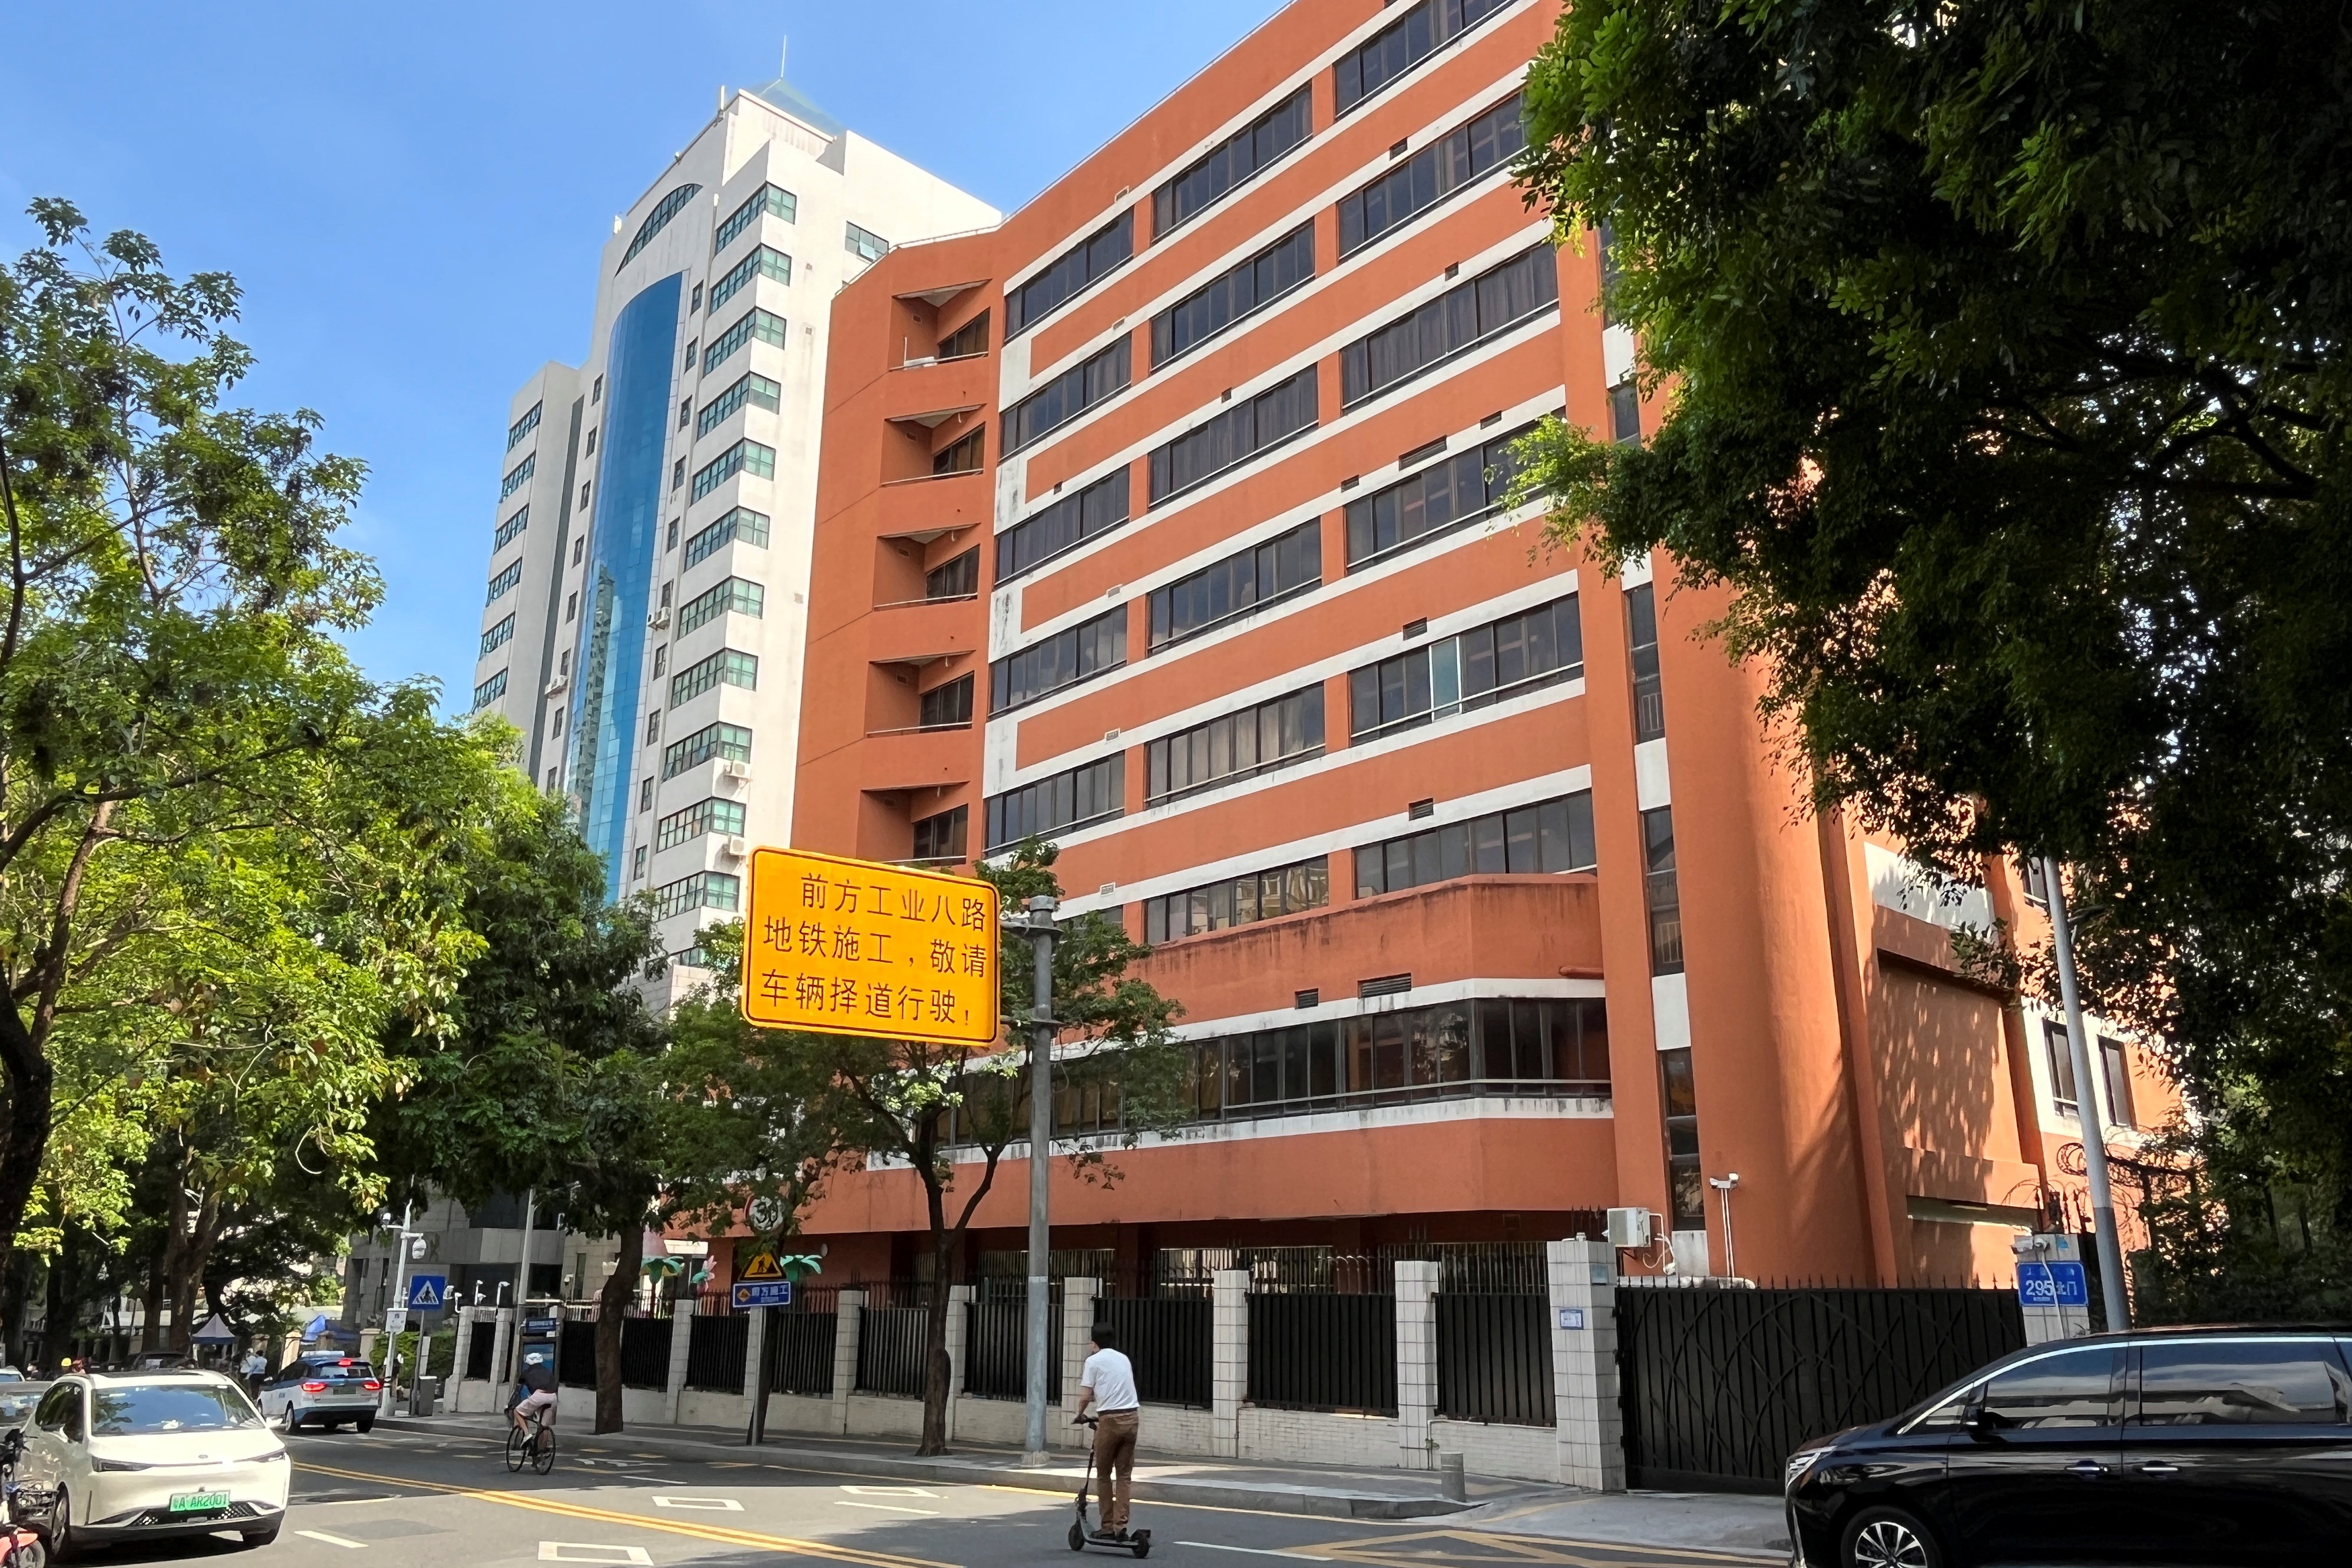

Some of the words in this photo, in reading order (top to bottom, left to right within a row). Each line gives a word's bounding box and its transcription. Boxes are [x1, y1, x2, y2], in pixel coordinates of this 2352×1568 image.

[801, 872, 986, 932] 前方工业八路
[763, 915, 987, 978] 地铁施工，敬请
[760, 968, 970, 1026] 车辆择道行驶！
